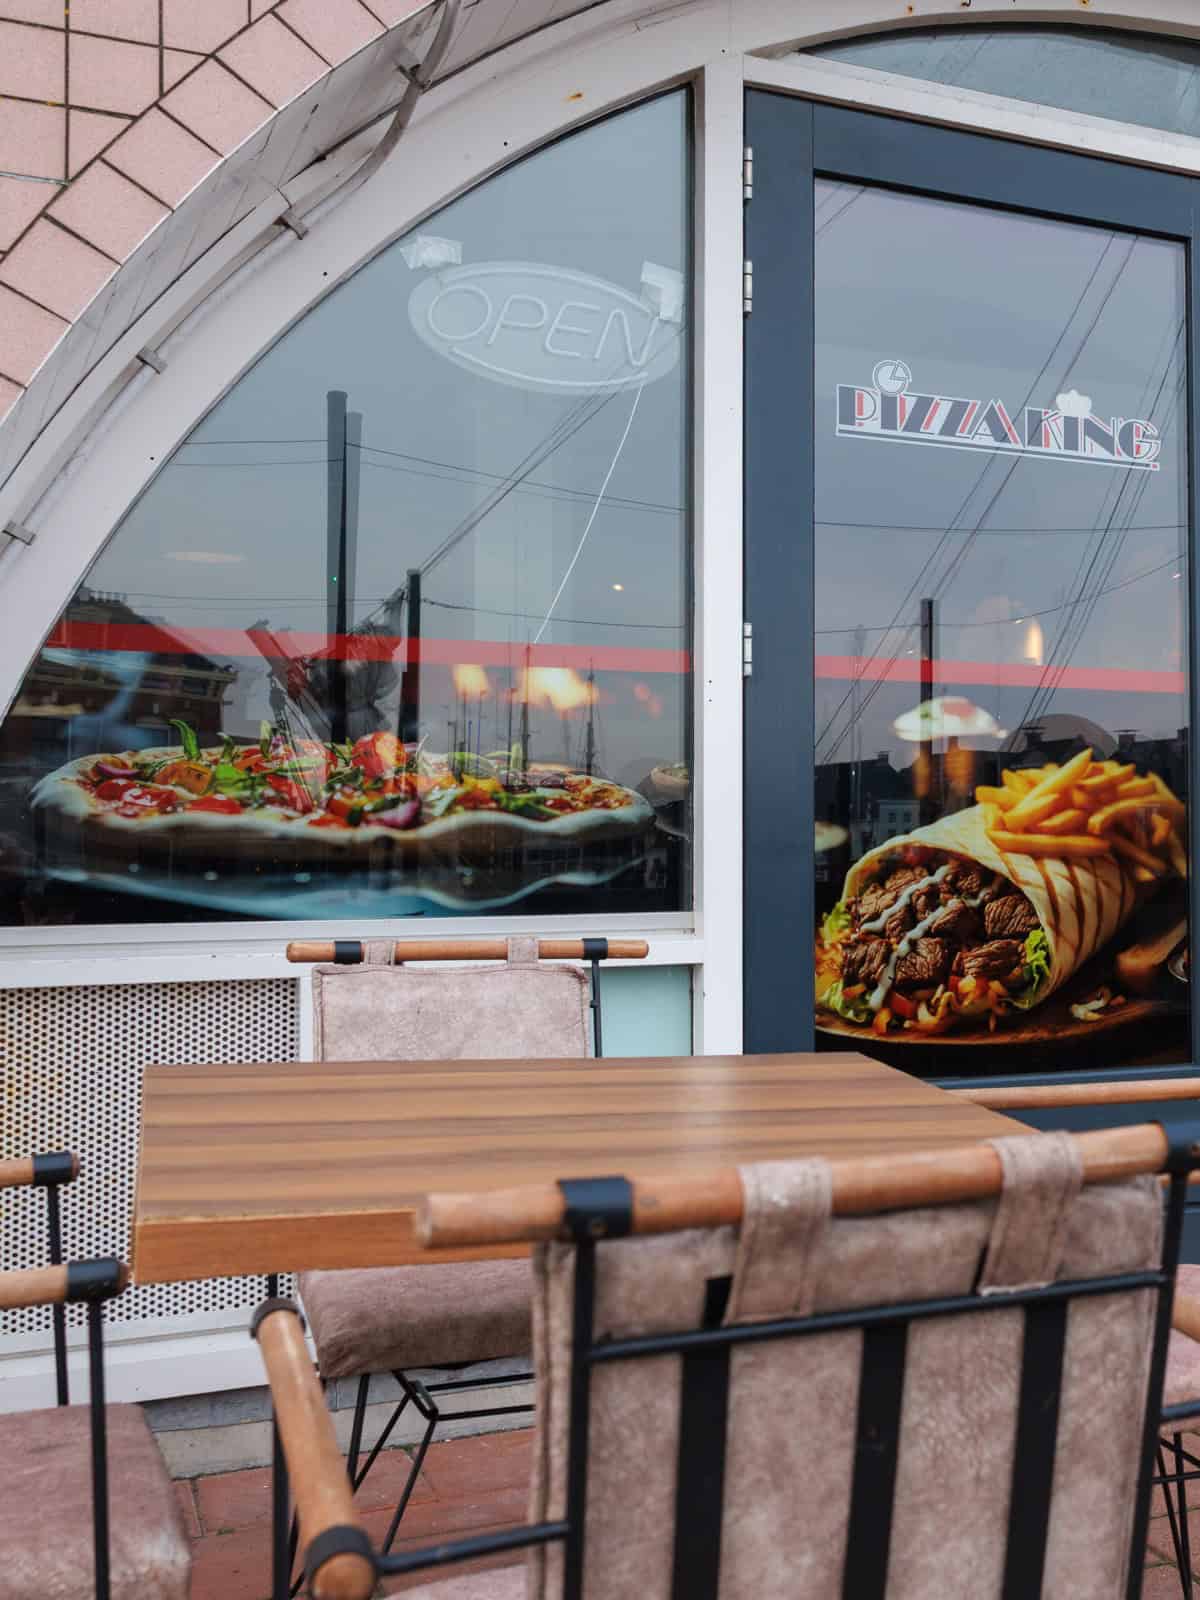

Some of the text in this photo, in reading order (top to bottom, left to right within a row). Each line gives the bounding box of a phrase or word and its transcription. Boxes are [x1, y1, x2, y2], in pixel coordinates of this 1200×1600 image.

[428, 284, 660, 368] OPEN
[836, 382, 1162, 461] PIZZA KING
